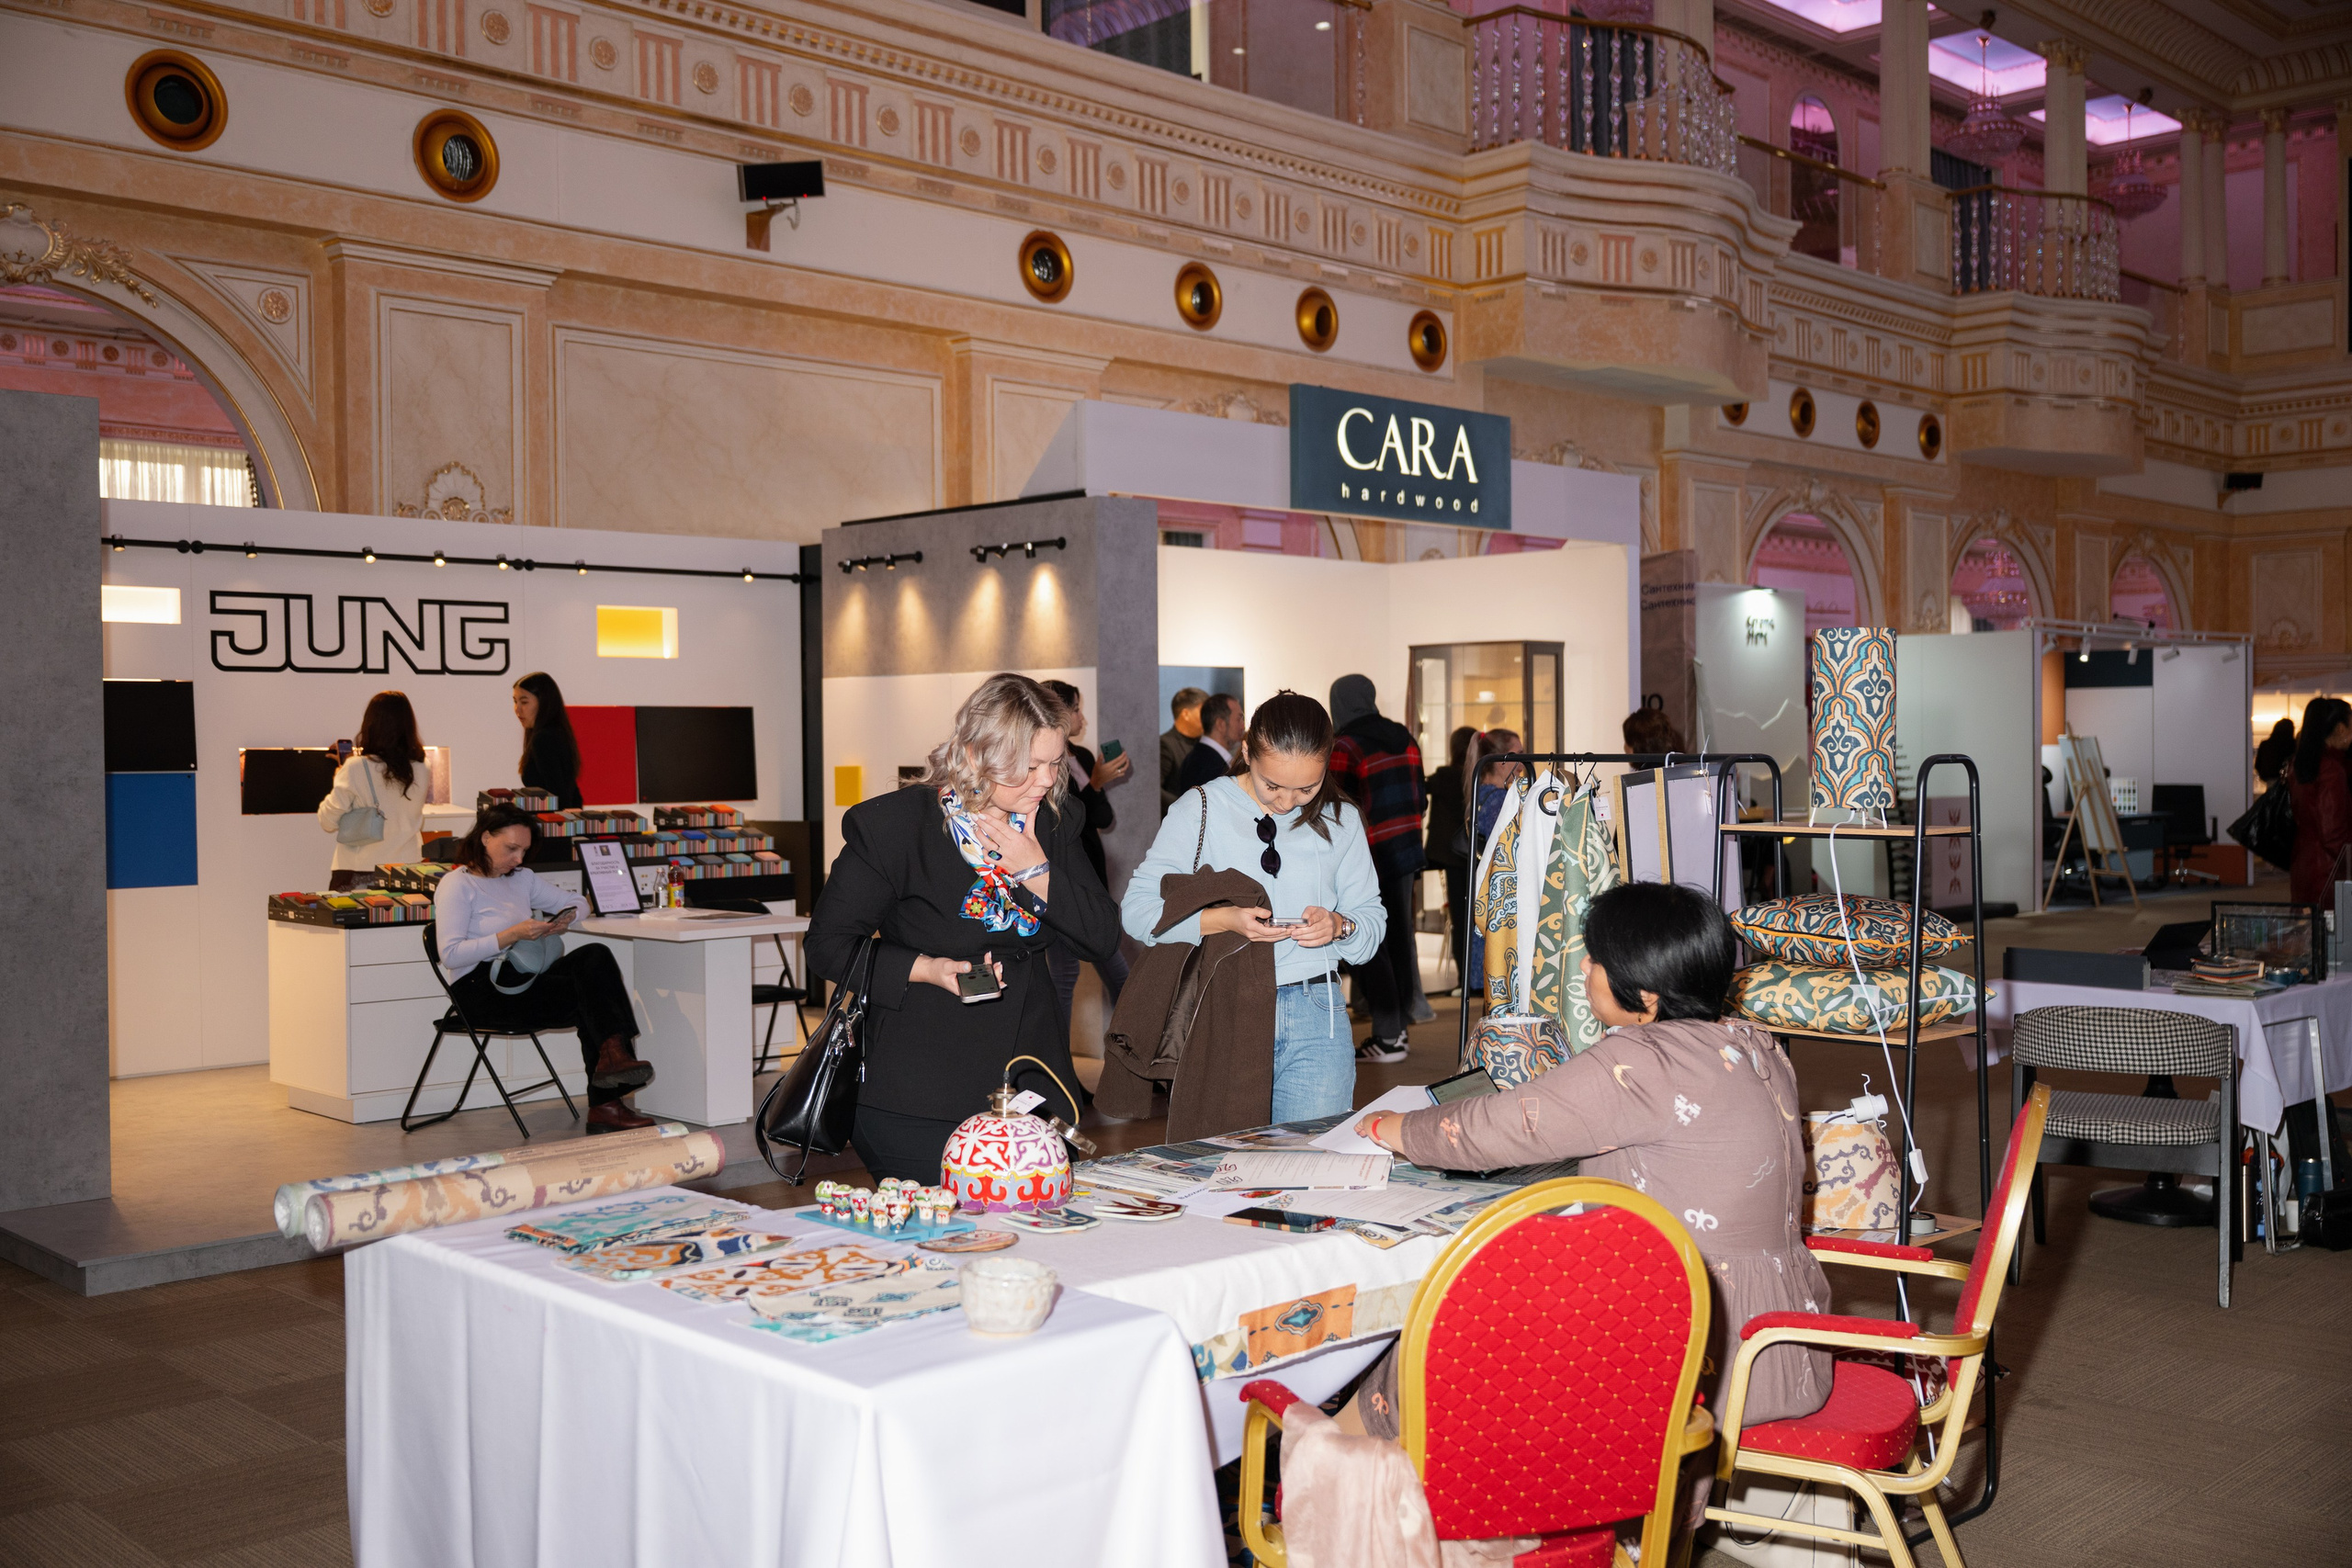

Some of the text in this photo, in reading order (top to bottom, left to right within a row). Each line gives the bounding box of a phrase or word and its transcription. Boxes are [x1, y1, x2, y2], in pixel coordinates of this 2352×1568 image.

[1337, 407, 1478, 483] CARA
[1341, 482, 1478, 513] hardwood
[209, 590, 510, 675] JUNG
